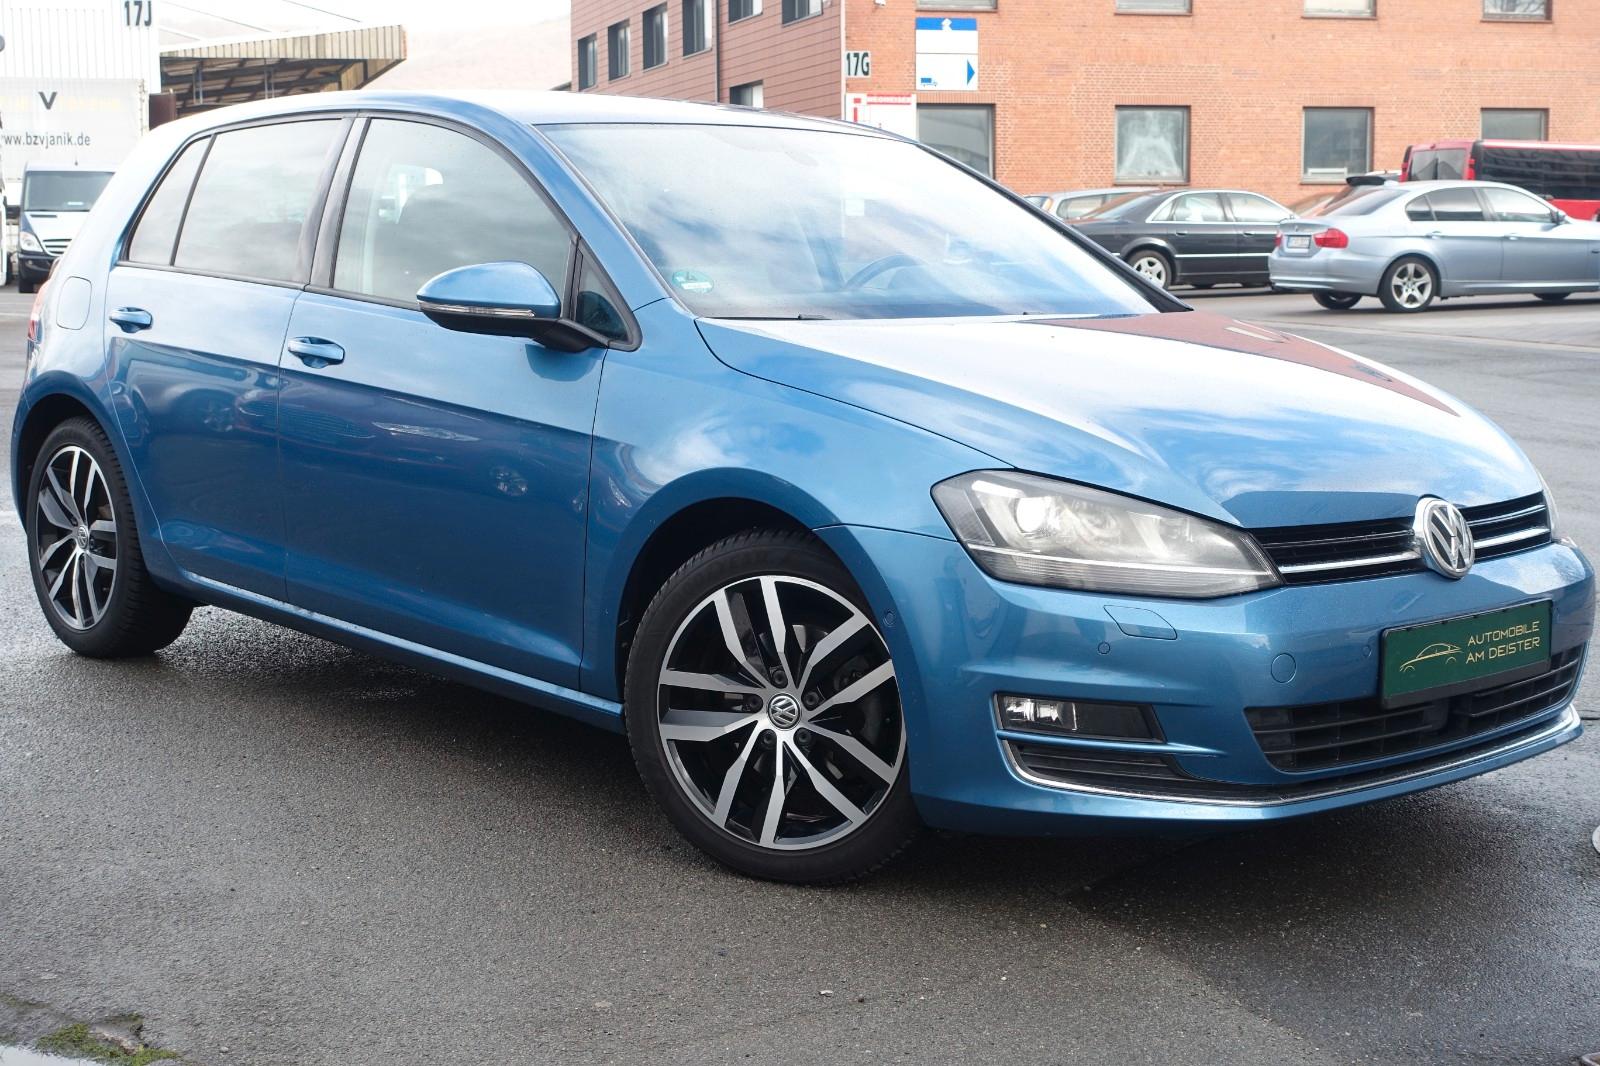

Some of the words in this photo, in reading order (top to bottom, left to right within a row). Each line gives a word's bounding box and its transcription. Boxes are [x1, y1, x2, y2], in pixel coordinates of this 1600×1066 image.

[124, 0, 152, 26] 17J
[846, 52, 870, 76] 17G
[38, 91, 58, 110] V
[1, 131, 91, 149] ww.bzvjanik.de
[1467, 620, 1540, 647] AUTOMOBILE
[1465, 650, 1485, 665] AM
[1488, 636, 1541, 659] DEISTER
